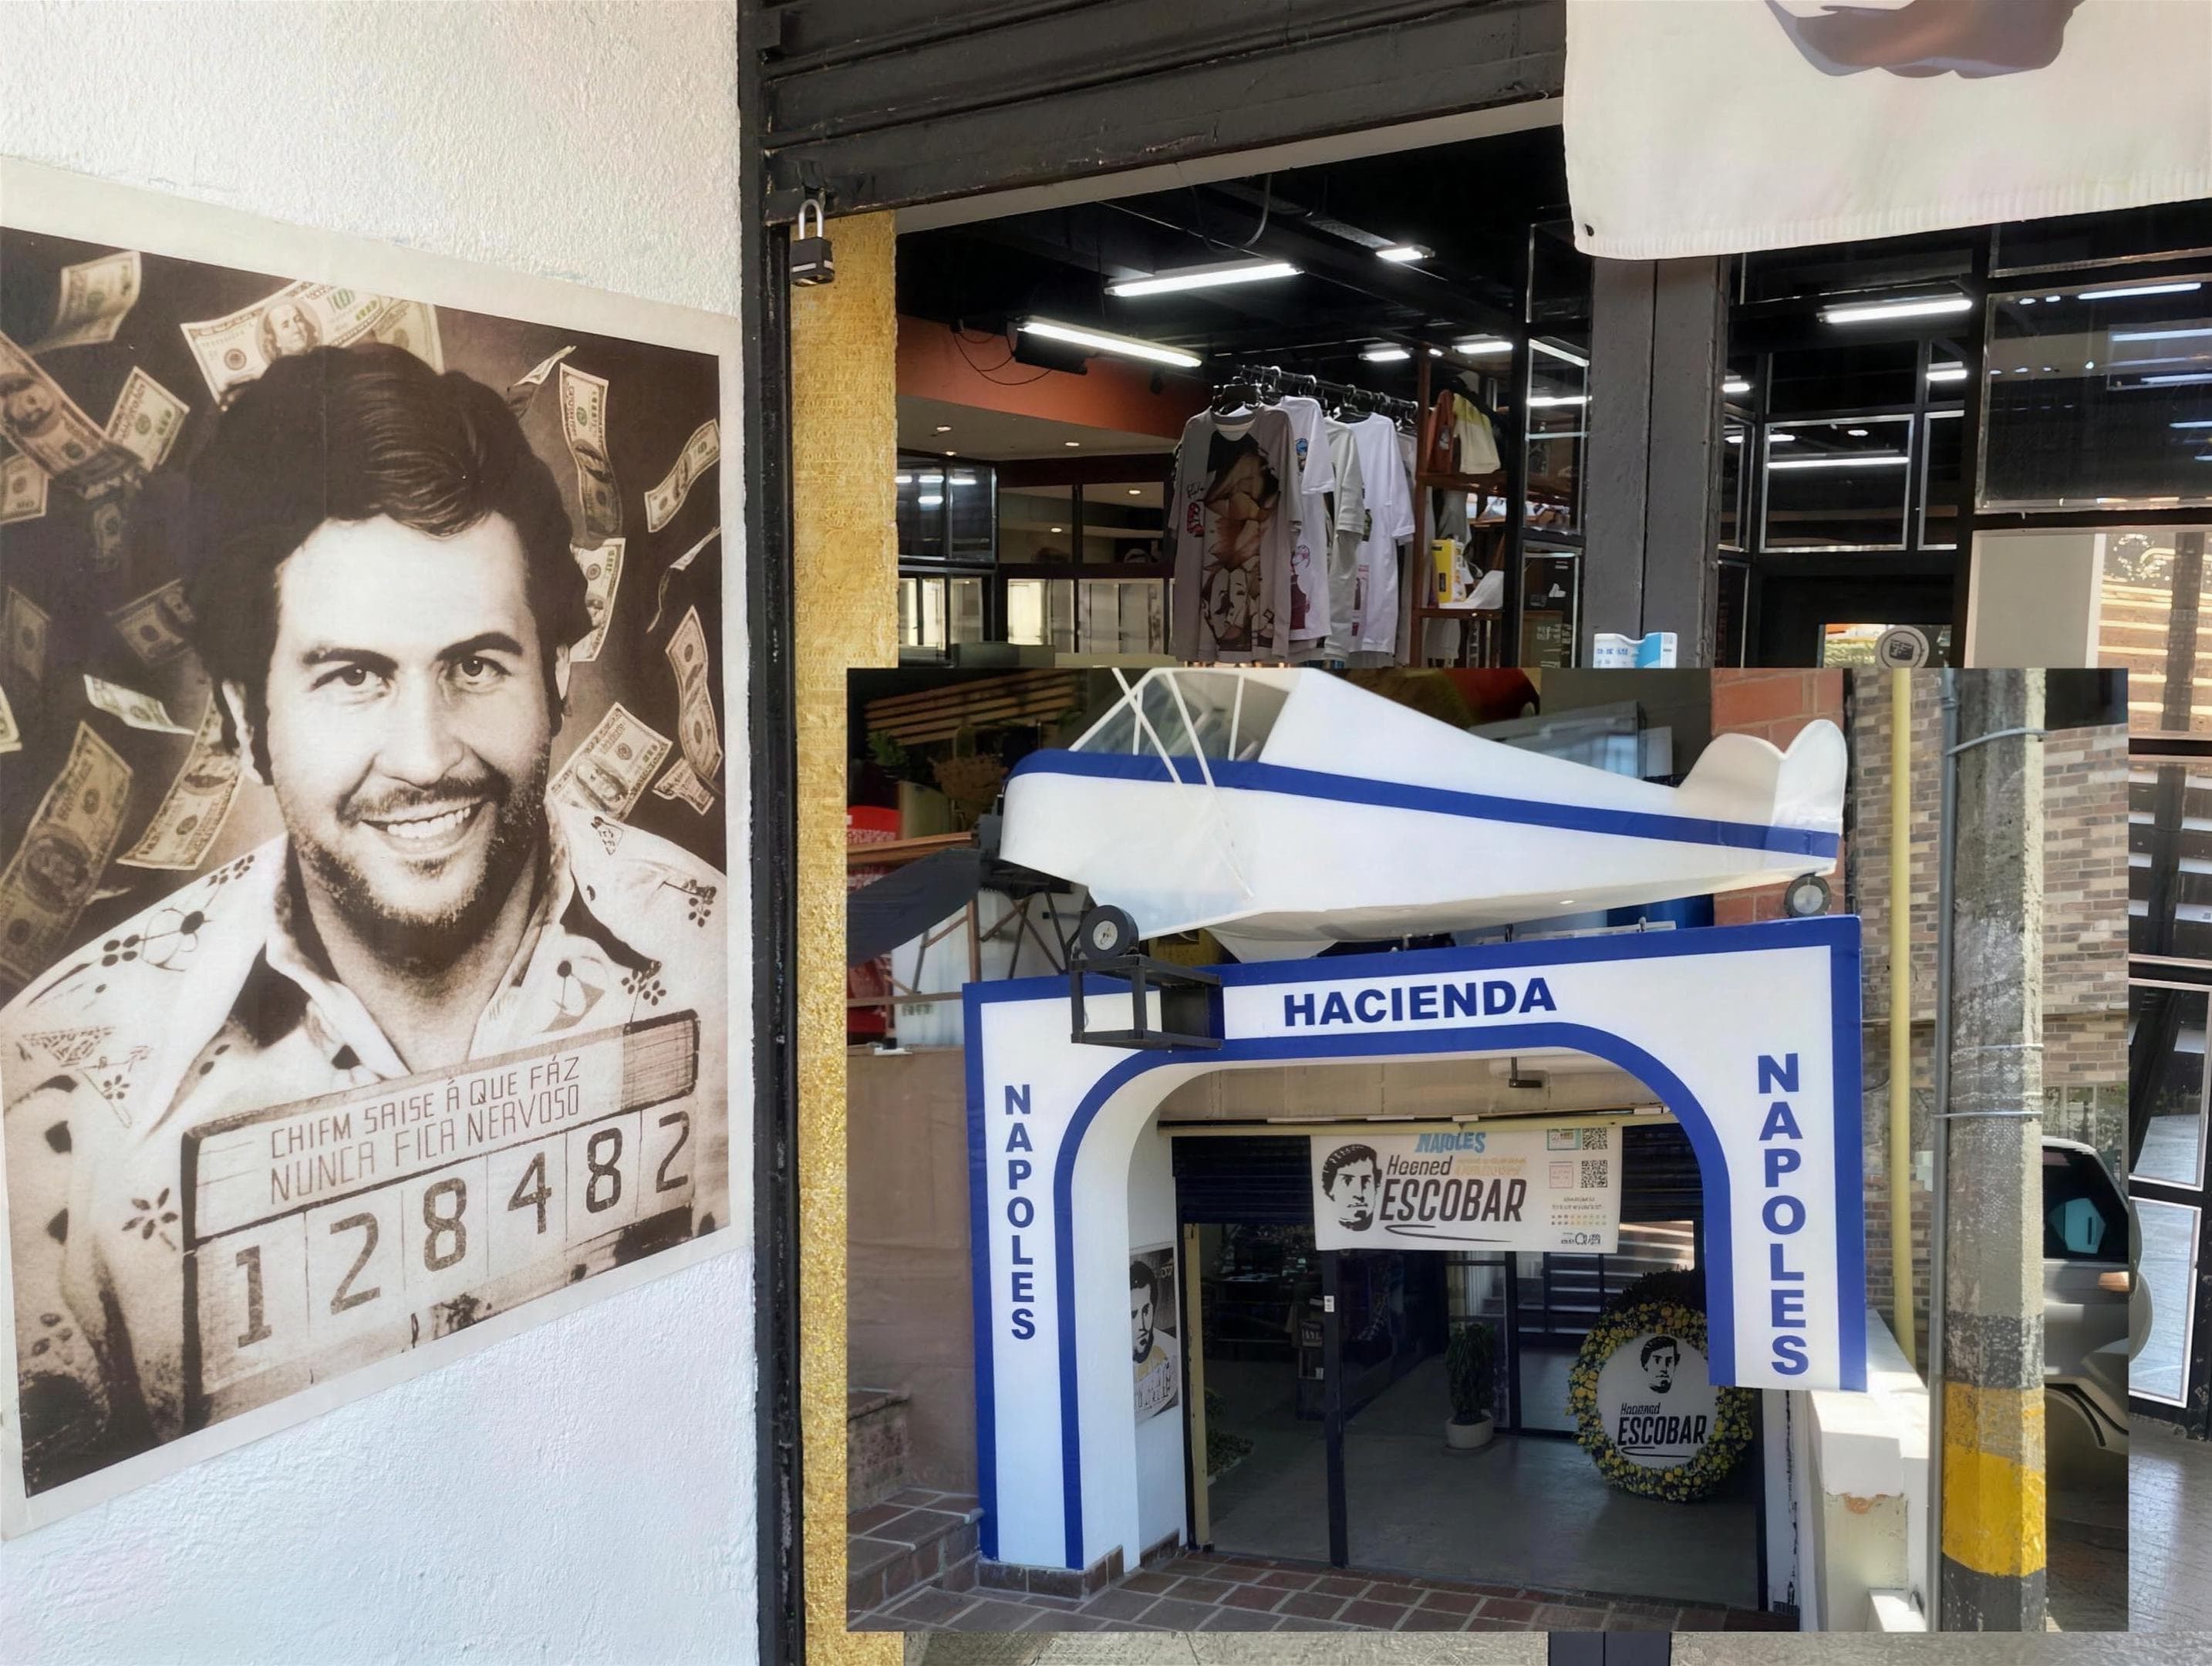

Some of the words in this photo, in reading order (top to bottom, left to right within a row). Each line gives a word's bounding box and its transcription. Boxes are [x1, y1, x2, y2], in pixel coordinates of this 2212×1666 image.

[1283, 976, 1557, 1027] HACIENDA
[364, 1093, 434, 1135] SAISE
[470, 1071, 518, 1105] QUE
[530, 1055, 579, 1091] FÁZ
[271, 1141, 375, 1205] NUNCA
[394, 1118, 455, 1167] FICA
[467, 1083, 579, 1147] NERVOSO
[1004, 1084, 1036, 1340] NAPOLES
[1379, 1179, 1527, 1222] ESCOBAR
[1758, 1053, 1809, 1376] NAPOLES
[1617, 1415, 1708, 1445] ESCOBAR
